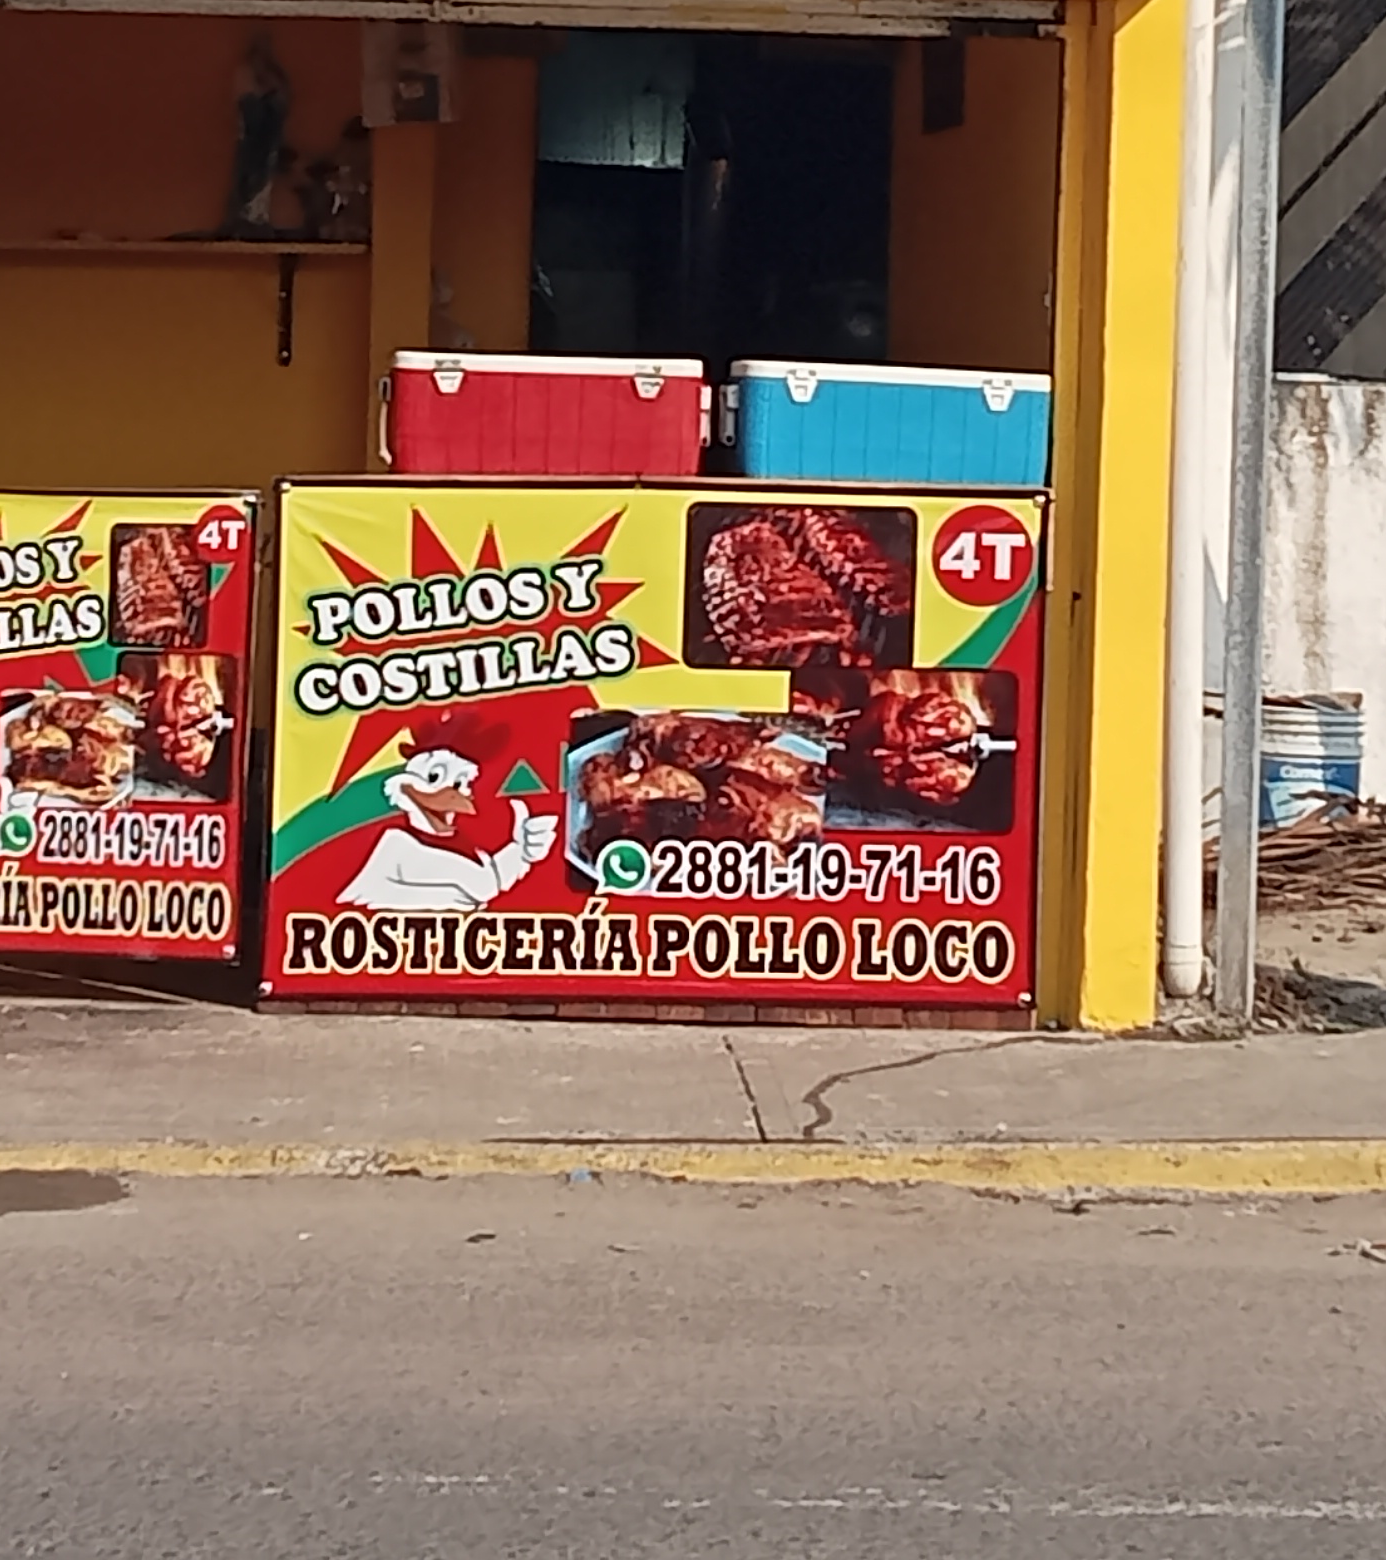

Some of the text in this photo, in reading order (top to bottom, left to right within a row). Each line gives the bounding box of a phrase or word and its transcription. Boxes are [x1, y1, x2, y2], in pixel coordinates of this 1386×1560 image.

[44, 536, 83, 582] Y
[198, 520, 247, 551] 4T
[939, 530, 1026, 583] 4T
[308, 561, 604, 648] POLLOS Y
[295, 626, 638, 715] COSTILLAS
[37, 809, 226, 867] 2881-19-71-16
[651, 841, 1000, 905] 2881-19-71-16
[39, 881, 144, 935] POLLO
[146, 883, 231, 940] LOCO
[285, 897, 1013, 984] ROSTICERÍA POLLO LOCO
